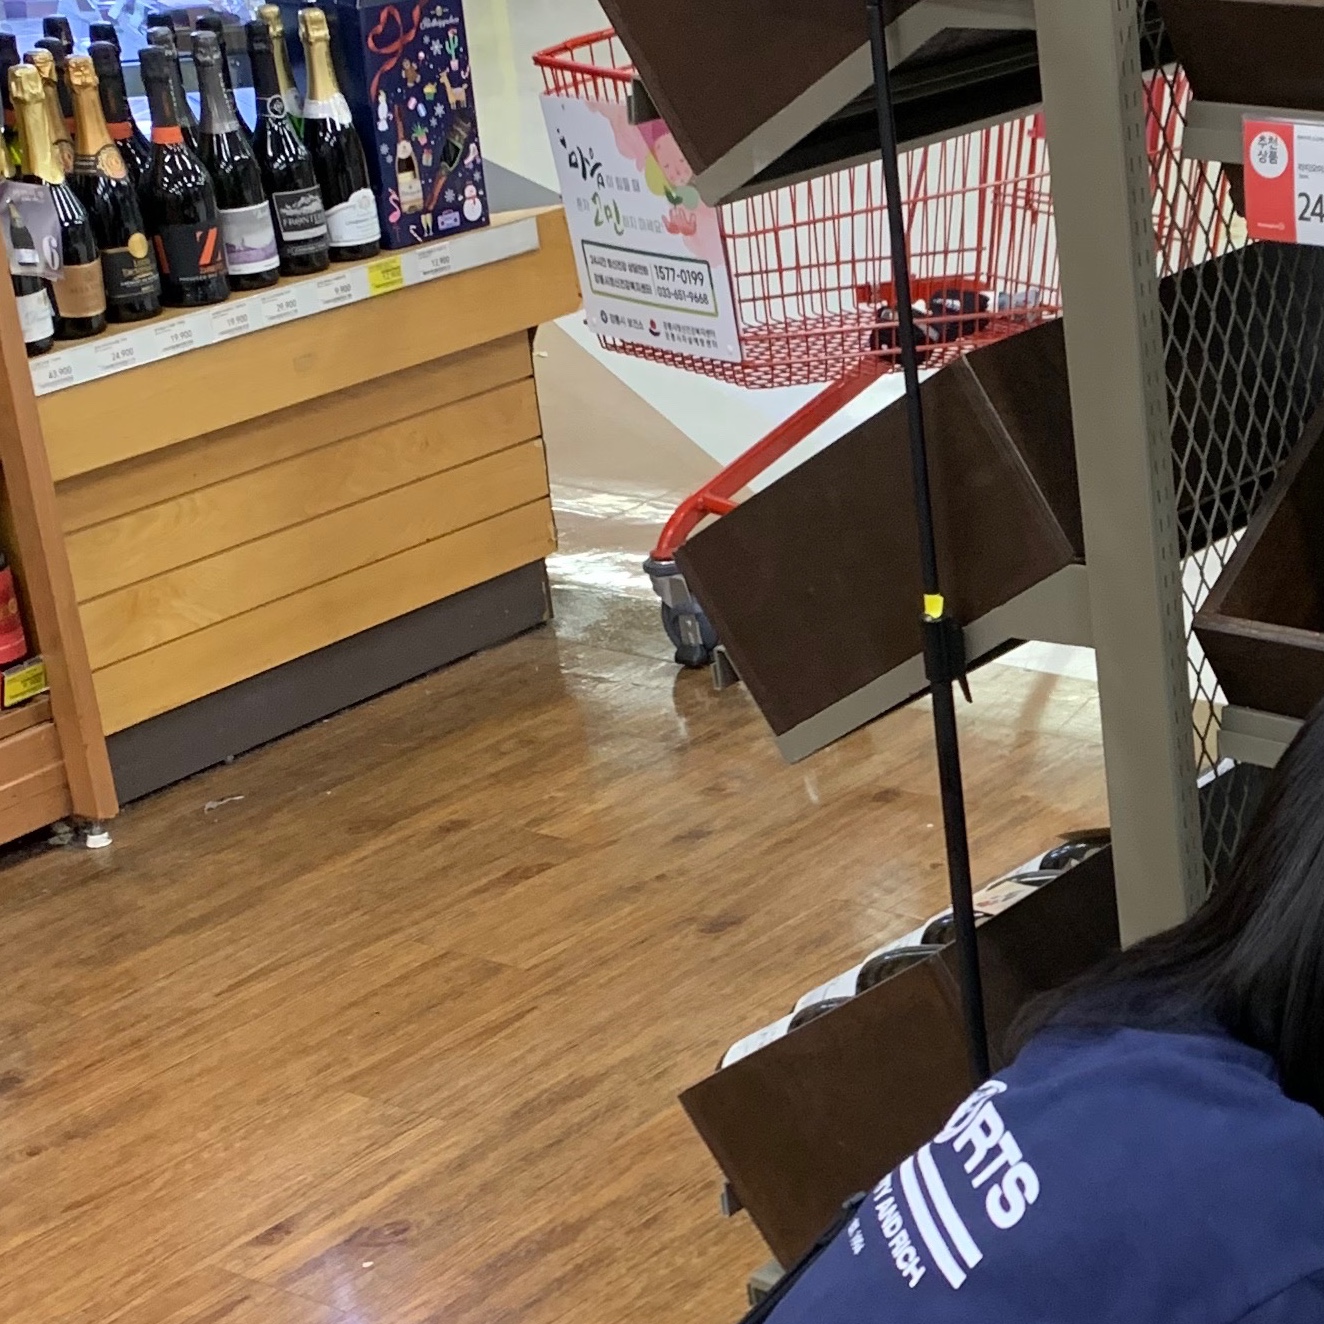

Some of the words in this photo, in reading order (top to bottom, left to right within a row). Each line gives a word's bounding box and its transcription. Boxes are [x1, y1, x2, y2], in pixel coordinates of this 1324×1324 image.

[1258, 135, 1278, 150] 추천
[1257, 150, 1279, 165] 상품
[654, 264, 704, 285] 1577-0199
[657, 286, 709, 305] 033-651-9668
[874, 1196, 904, 1239] AND
[888, 1228, 927, 1288] RICH
